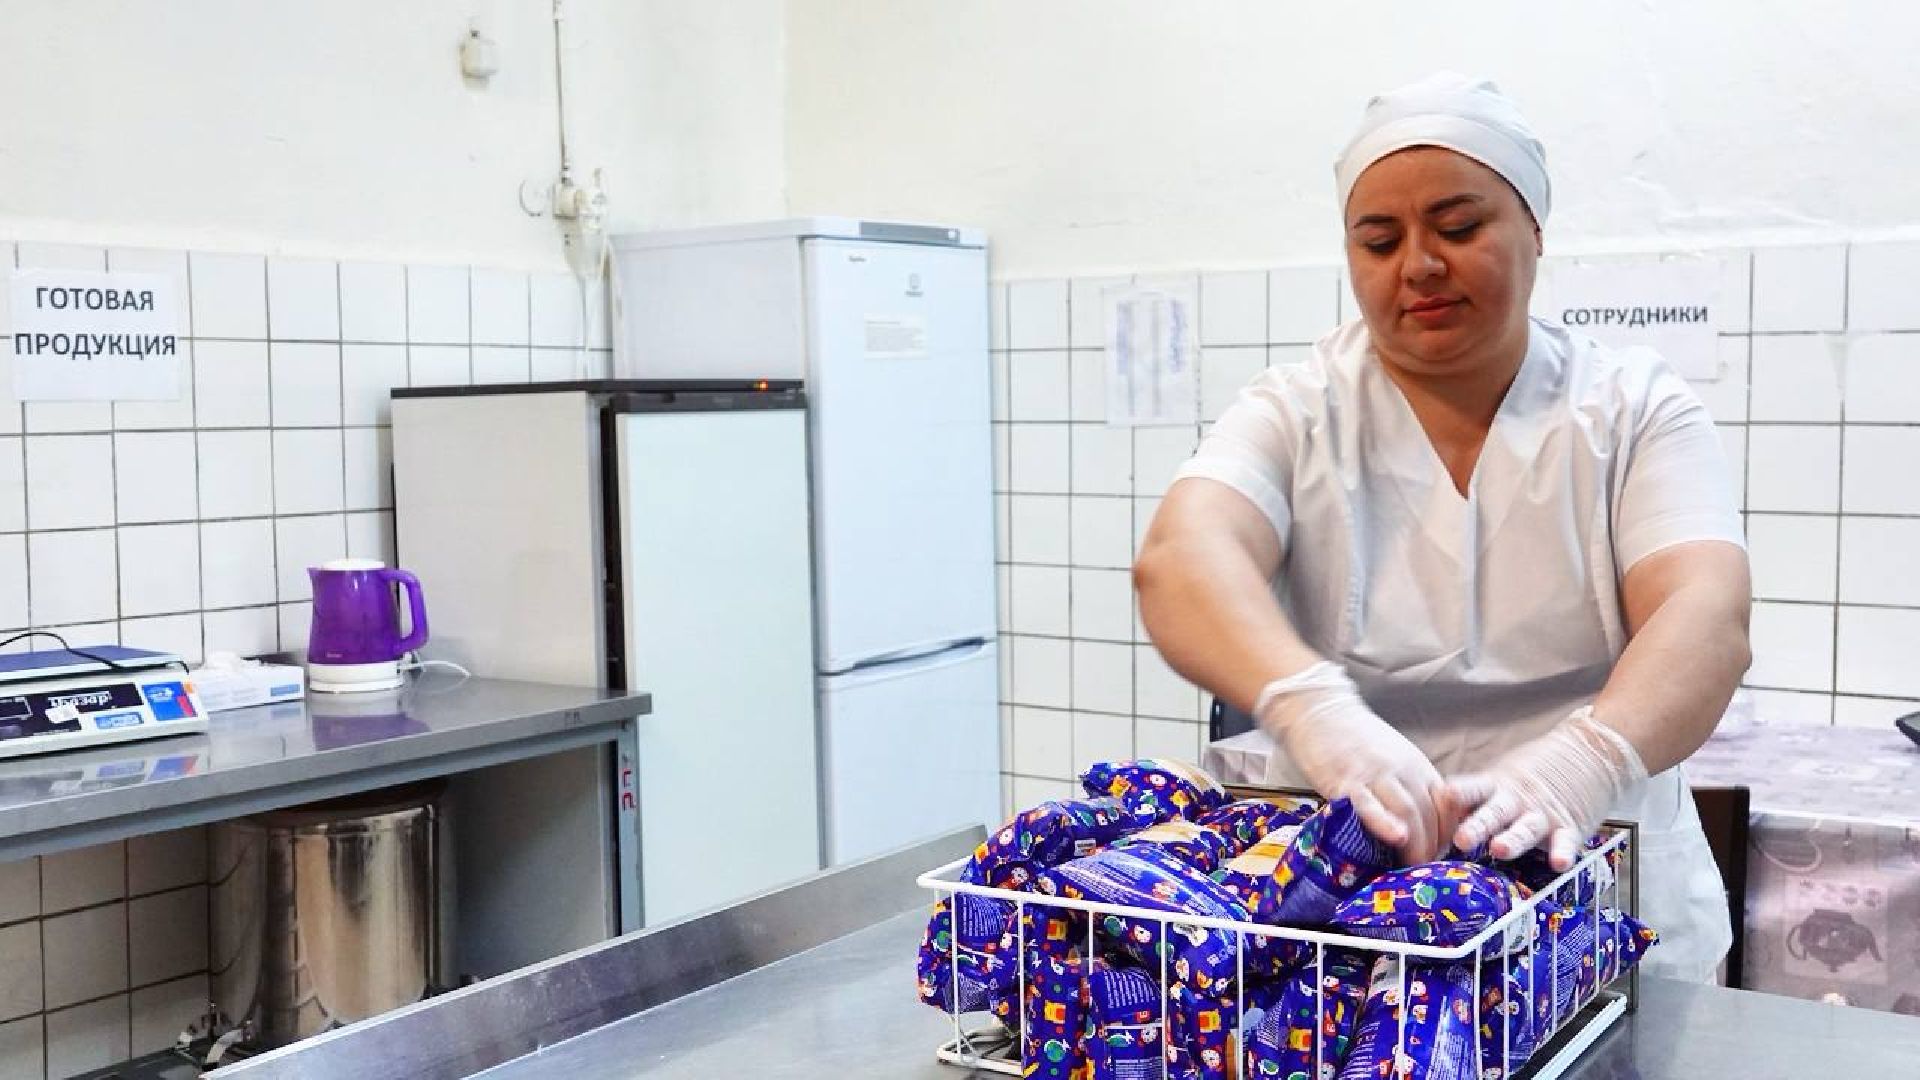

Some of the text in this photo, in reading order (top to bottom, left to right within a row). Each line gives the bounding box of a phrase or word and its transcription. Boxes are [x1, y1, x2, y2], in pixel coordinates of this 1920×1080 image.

[36, 287, 154, 311] ГОТОВАЯ
[1562, 306, 1708, 328] СОТРУДНИКИ
[15, 333, 176, 360] ПРОДУКЦИЯ
